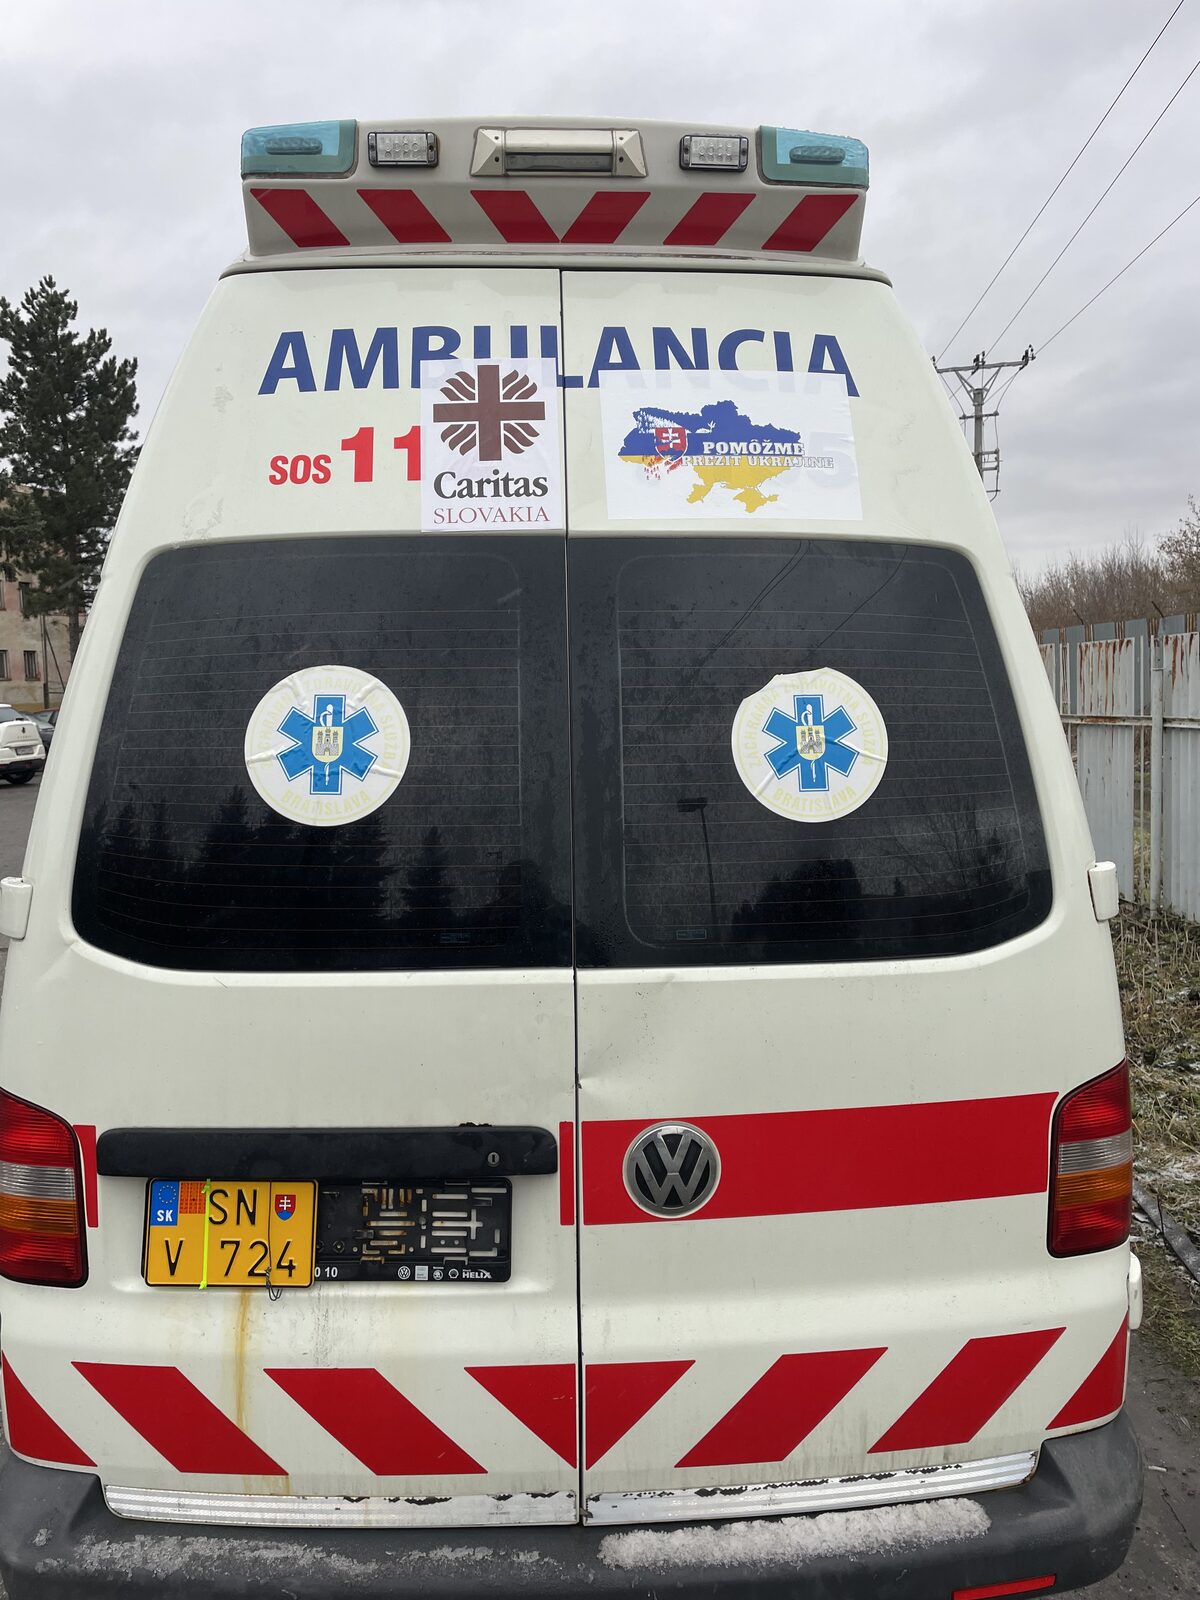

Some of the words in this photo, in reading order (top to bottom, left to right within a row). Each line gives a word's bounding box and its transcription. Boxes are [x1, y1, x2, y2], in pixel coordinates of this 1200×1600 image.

[702, 438, 805, 455] POMÔŽME
[268, 454, 332, 485] SOS
[433, 469, 549, 499] Caritas
[433, 506, 551, 524] SLOVAKIA
[156, 1209, 173, 1222] SK
[209, 1188, 257, 1226] SN
[164, 1240, 184, 1276] V
[220, 1240, 296, 1278] 724
[324, 1266, 338, 1278] 10
[462, 1270, 493, 1279] HELIX
